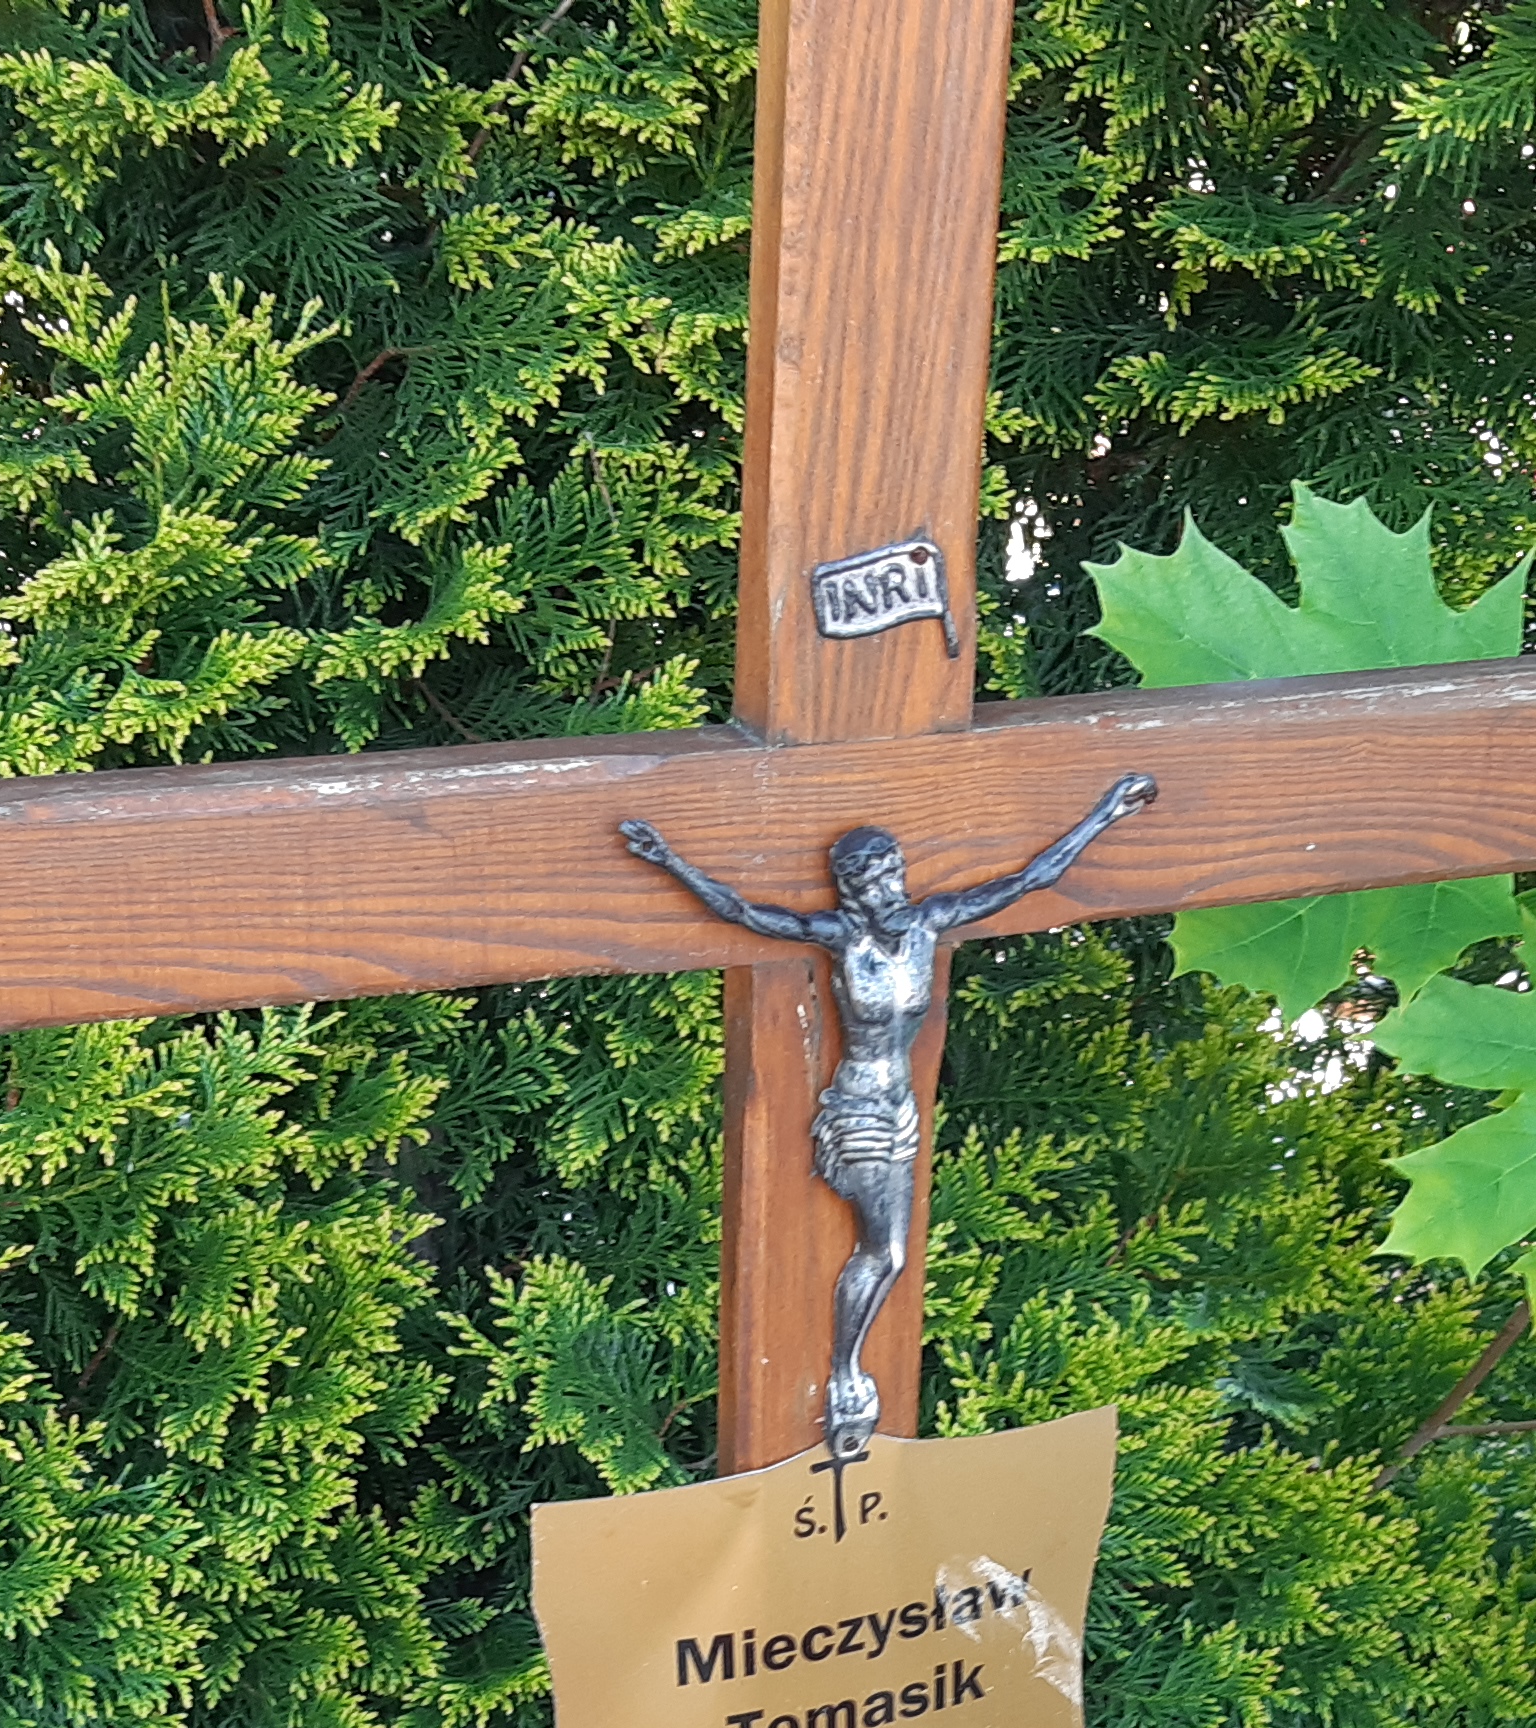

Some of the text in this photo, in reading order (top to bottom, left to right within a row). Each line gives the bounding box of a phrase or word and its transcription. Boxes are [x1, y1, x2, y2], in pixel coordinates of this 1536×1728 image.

[823, 562, 928, 623] INRI
[859, 1491, 889, 1525] P.
[675, 1566, 1033, 1687] Mieczysław
